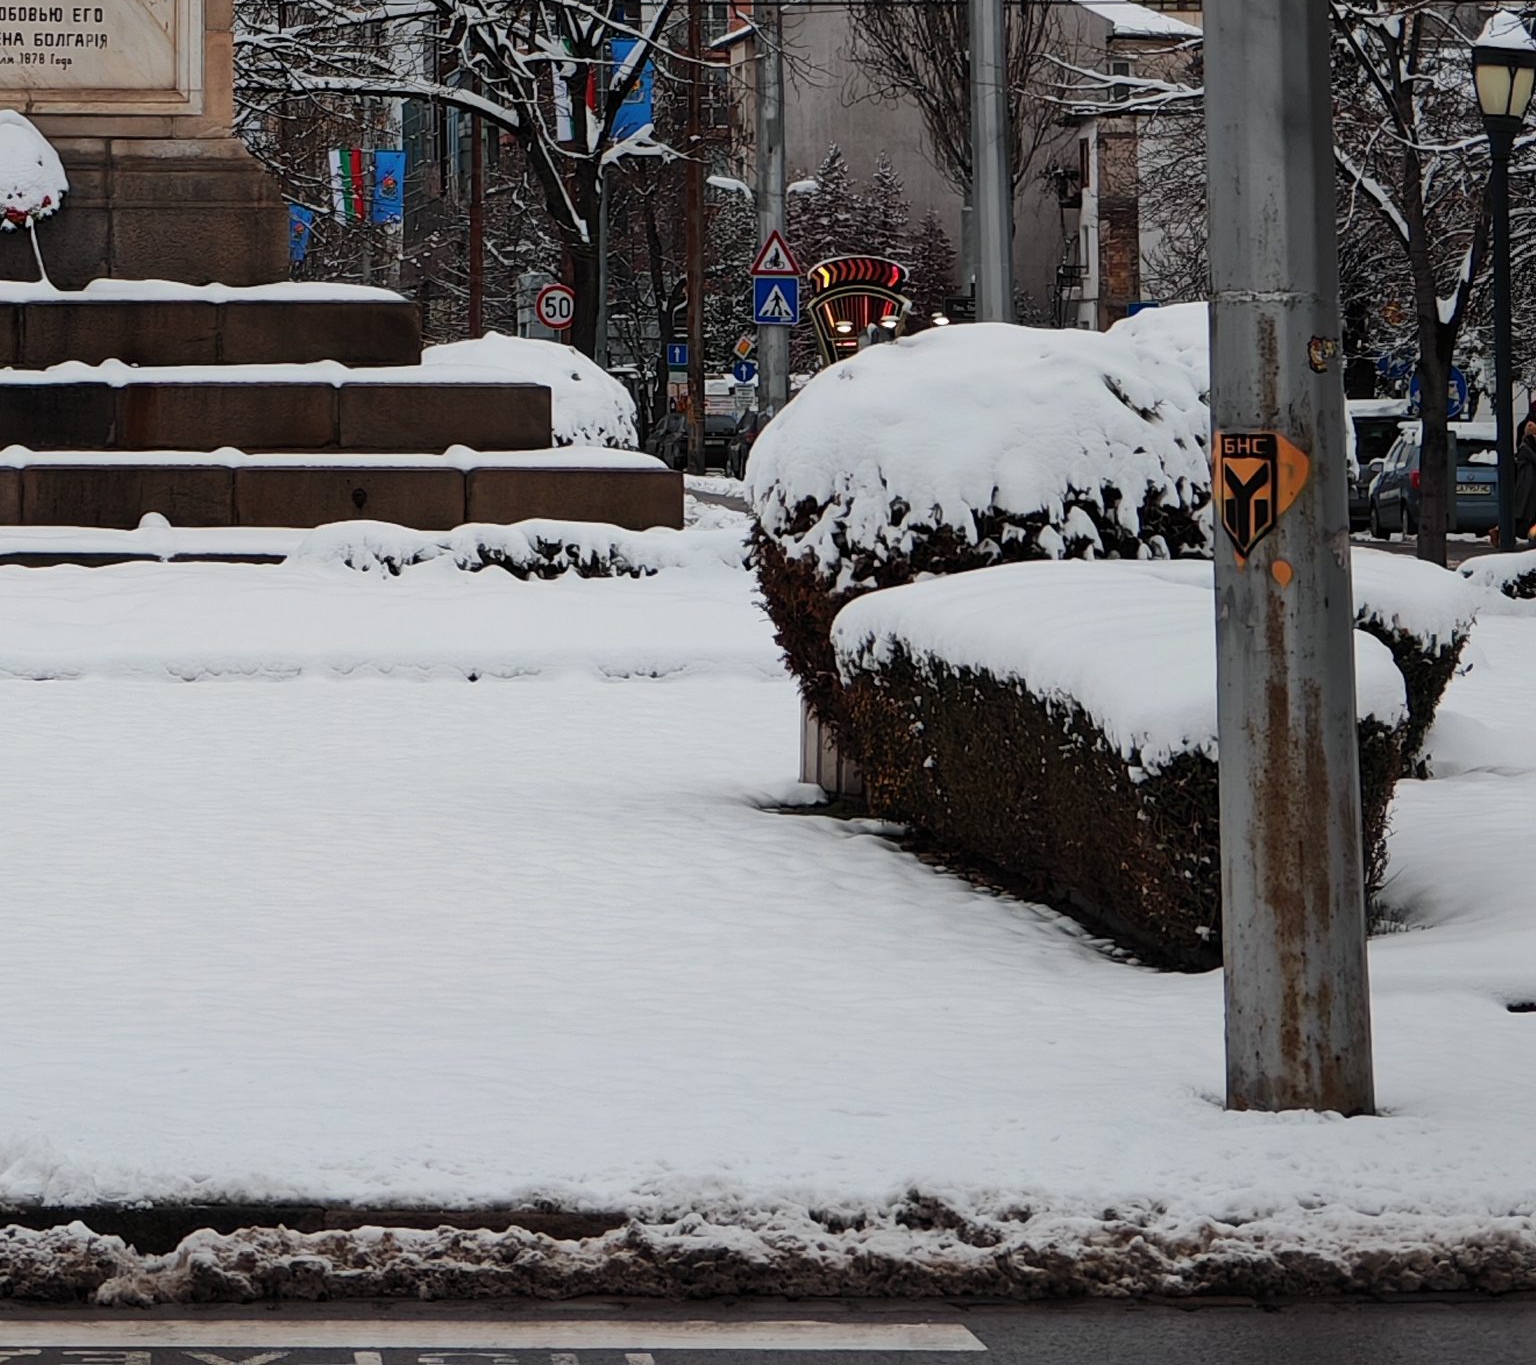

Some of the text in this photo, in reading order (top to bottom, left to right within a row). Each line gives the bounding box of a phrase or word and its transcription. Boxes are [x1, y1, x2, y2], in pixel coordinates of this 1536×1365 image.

[72, 7, 103, 23] ЕГО
[19, 52, 45, 65] 1878
[545, 296, 571, 319] 50
[1224, 438, 1268, 455] БНС
